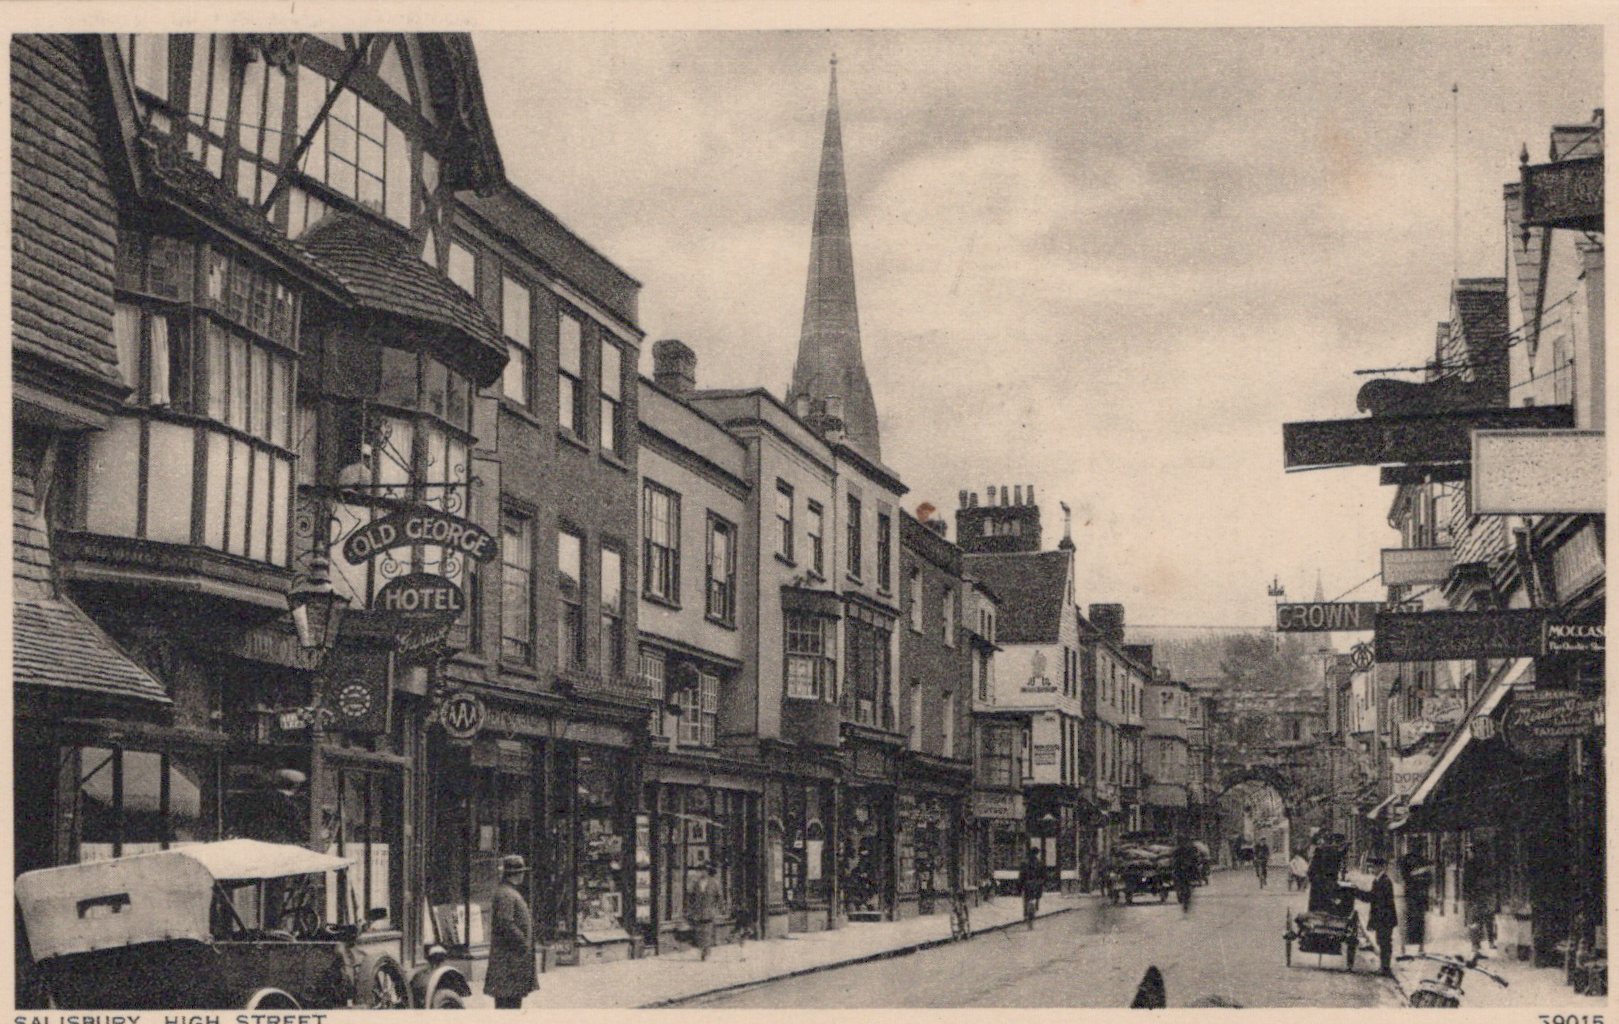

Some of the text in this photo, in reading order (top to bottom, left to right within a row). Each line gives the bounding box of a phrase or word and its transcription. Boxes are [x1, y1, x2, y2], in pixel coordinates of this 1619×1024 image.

[352, 518, 490, 556] OLD GEORGE
[385, 588, 460, 610] HOTEL
[1277, 604, 1360, 629] CROWN
